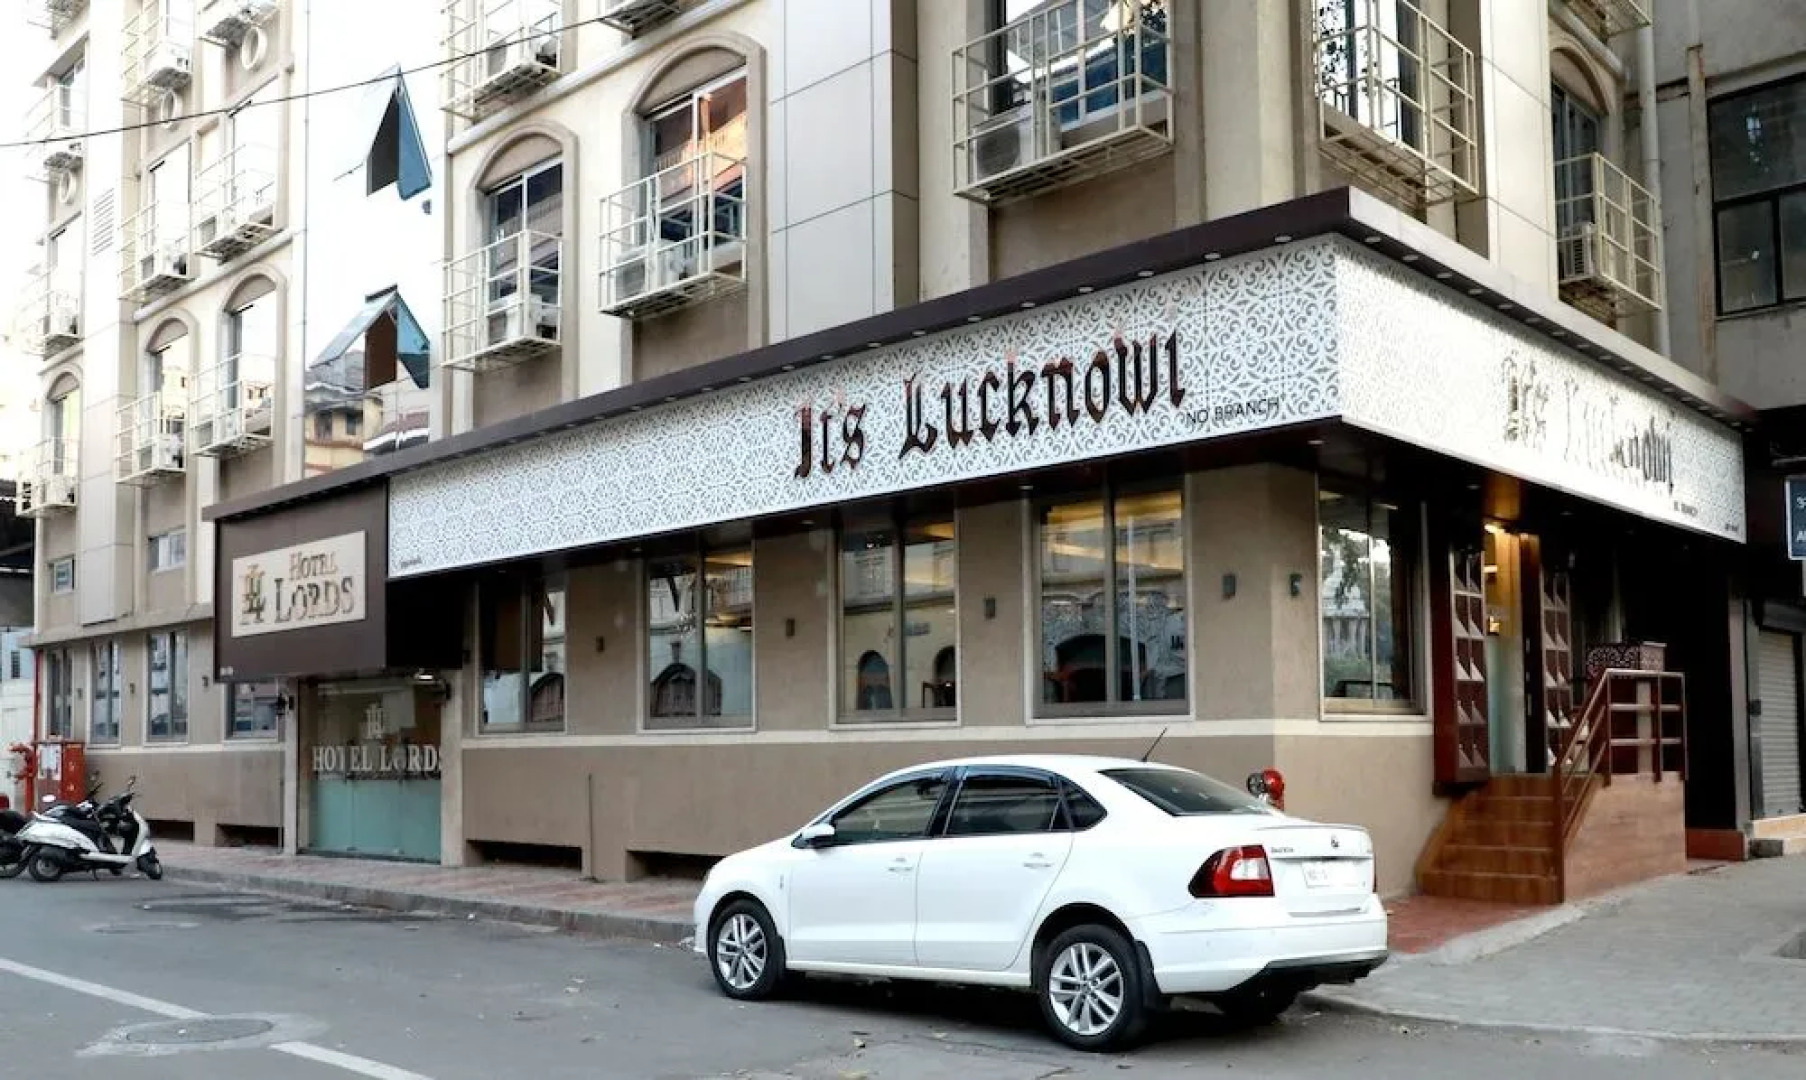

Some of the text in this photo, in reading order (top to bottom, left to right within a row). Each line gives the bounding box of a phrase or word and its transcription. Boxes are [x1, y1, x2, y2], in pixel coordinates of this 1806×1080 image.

[1186, 397, 1280, 425] NO BRANCH
[311, 744, 373, 772] HOTEL
